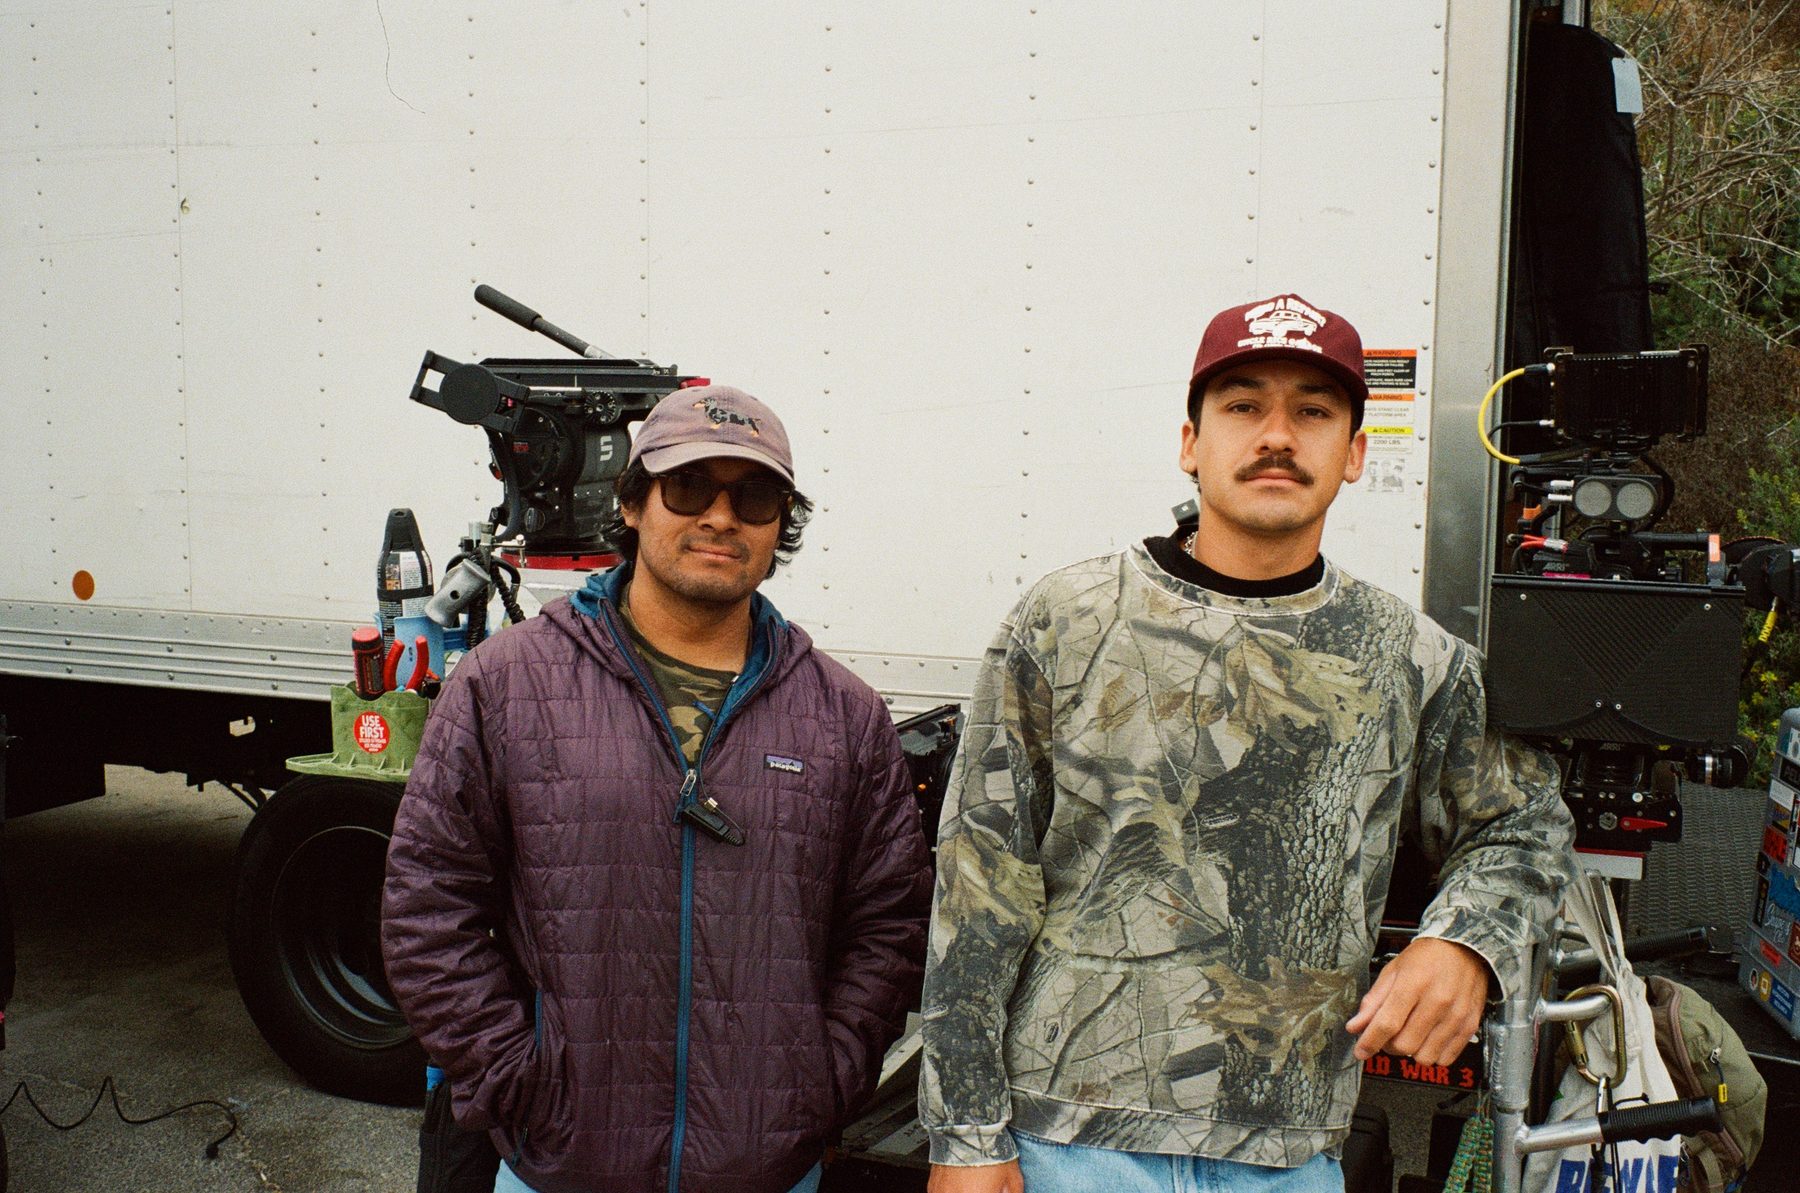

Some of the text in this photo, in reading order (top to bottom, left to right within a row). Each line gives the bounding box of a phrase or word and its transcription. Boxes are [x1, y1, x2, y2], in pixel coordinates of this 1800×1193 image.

[362, 715, 381, 727] USE
[359, 726, 385, 738] FIRST
[1400, 1058, 1450, 1086] WAR
[1459, 1067, 1474, 1088] 3
